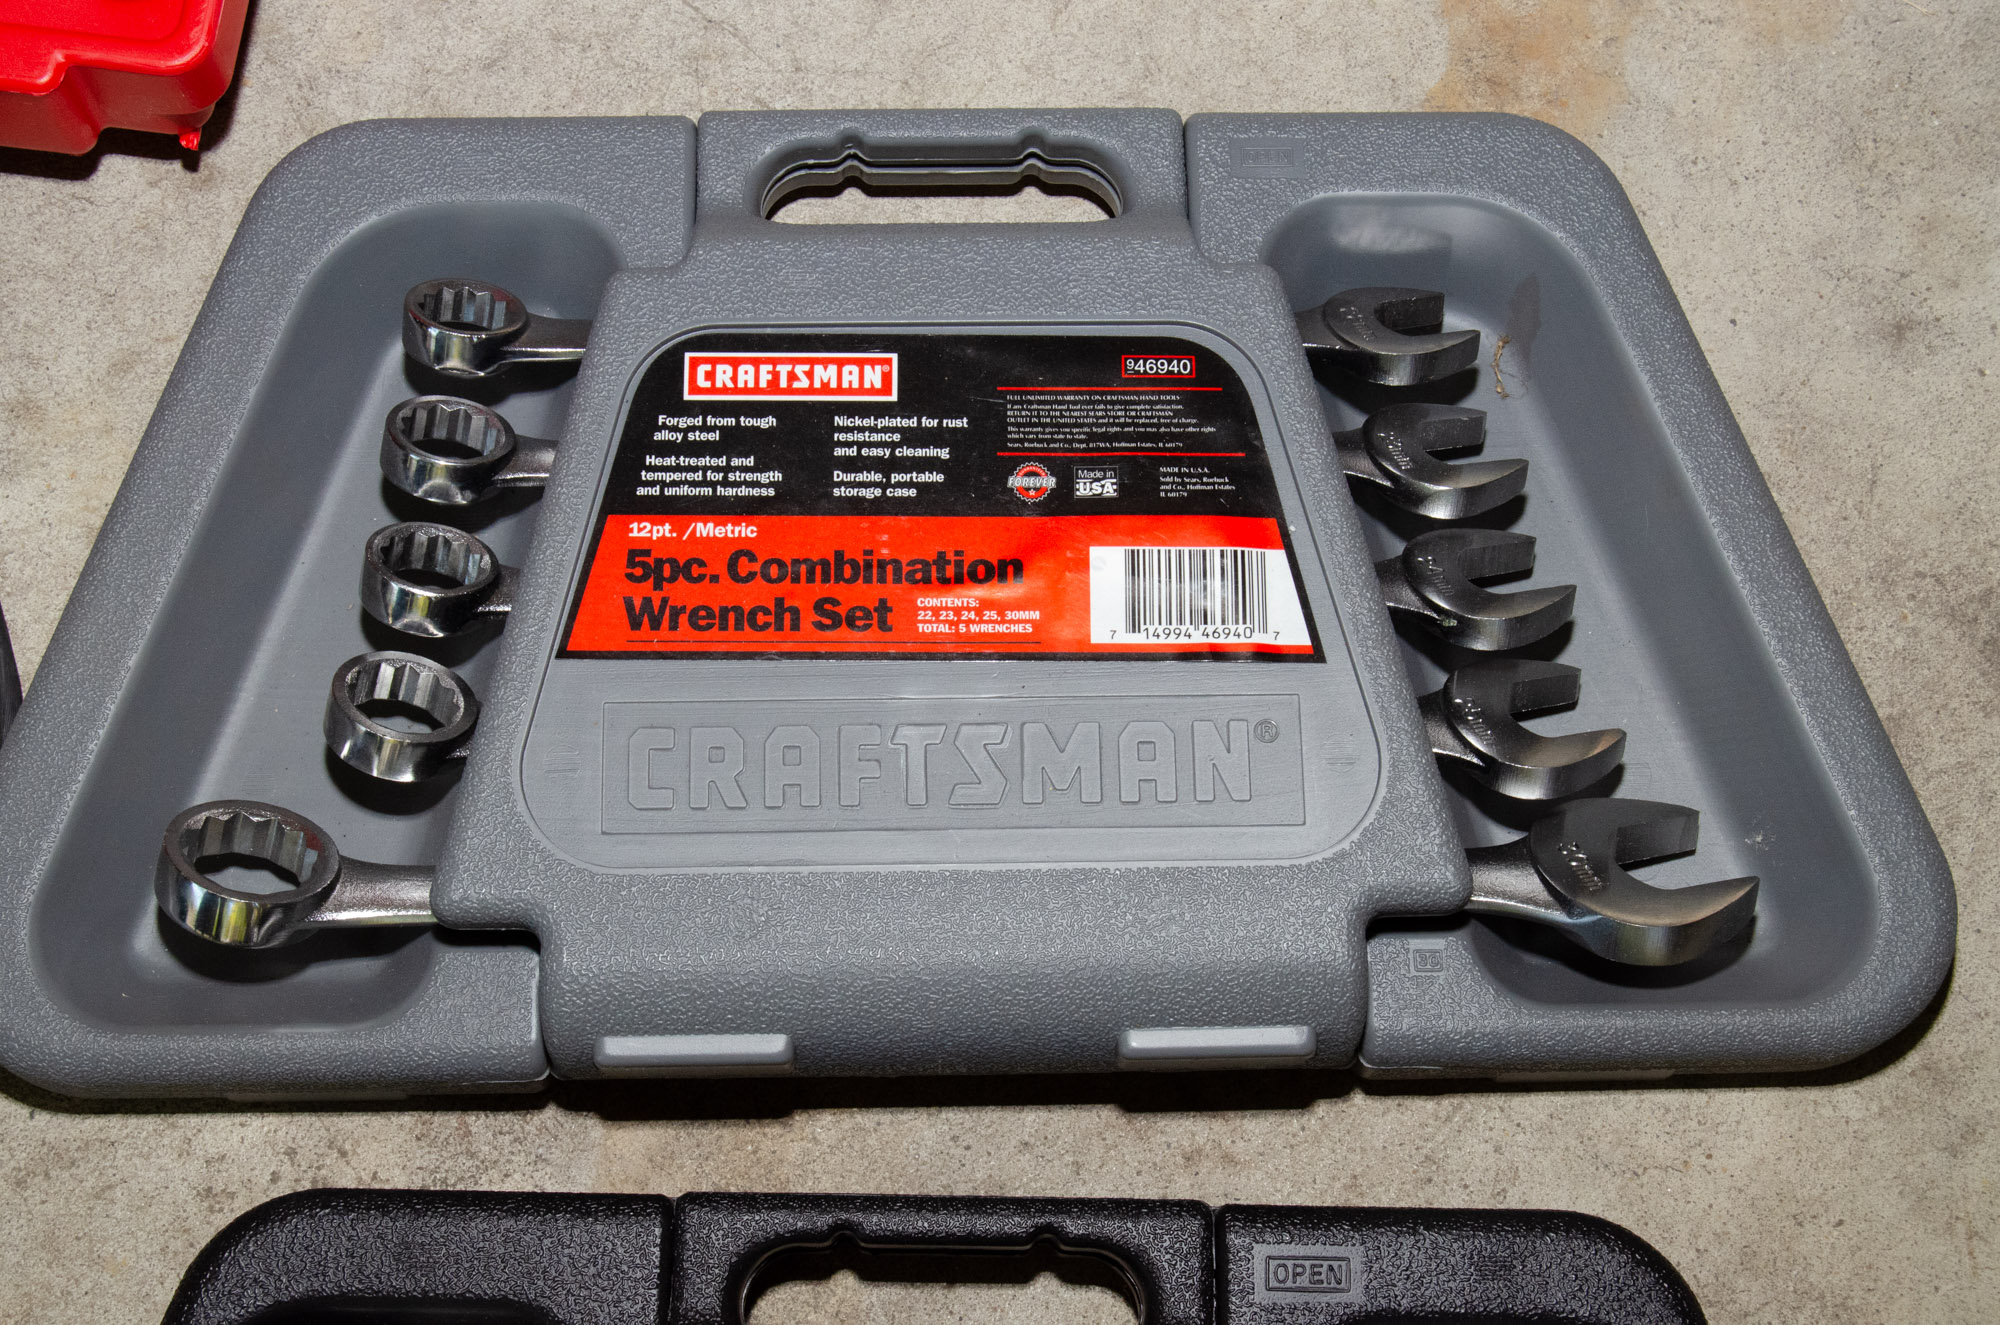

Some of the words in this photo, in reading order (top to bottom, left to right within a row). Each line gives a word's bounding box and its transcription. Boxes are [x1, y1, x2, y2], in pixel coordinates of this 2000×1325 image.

[1126, 359, 1190, 374] 946940
[658, 415, 702, 429] Forged
[707, 415, 735, 427] from
[739, 415, 777, 429] tough
[834, 416, 917, 429] Nickel-plated
[921, 416, 938, 427] for
[943, 417, 969, 428] rust
[653, 430, 683, 443] alloy
[688, 430, 720, 441] steel
[834, 431, 900, 442] resistance
[834, 445, 857, 456] and
[861, 448, 891, 458] easy
[895, 445, 950, 459] cleaning
[646, 455, 727, 466] Heat-treated
[730, 455, 754, 466] and
[641, 470, 703, 483] tempered
[706, 470, 724, 481] for
[728, 470, 782, 483] strength
[834, 471, 886, 483] Durable,
[891, 471, 944, 484] portable
[1078, 469, 1103, 478] Made
[1106, 469, 1114, 478] in
[1009, 477, 1056, 487] FOREVER
[1079, 482, 1114, 494] USA
[636, 485, 660, 496] and
[664, 485, 713, 496] uniform
[717, 485, 775, 496] hardness
[833, 487, 881, 498] storage
[885, 488, 917, 497] case
[629, 523, 677, 541] 12pt.
[684, 522, 757, 539] /Metric
[625, 549, 719, 592] 5pc.
[729, 549, 1024, 585] Combination
[917, 598, 979, 607] CONTENTS:
[624, 596, 805, 632] Wrench
[810, 596, 892, 632] Set
[917, 611, 936, 621] 22,
[939, 611, 958, 621] 23,
[961, 611, 979, 621] 24,
[982, 611, 1002, 621] 25,
[1004, 611, 1040, 621] 30MM
[917, 623, 955, 633] TOTAL:
[959, 623, 966, 633] 5
[969, 623, 1032, 633] WRENCHES
[1110, 630, 1117, 639] 7
[1143, 628, 1192, 639] 14994
[1202, 627, 1253, 639] 46940
[1273, 631, 1280, 641] 7
[1274, 1263, 1342, 1285] OPEN
